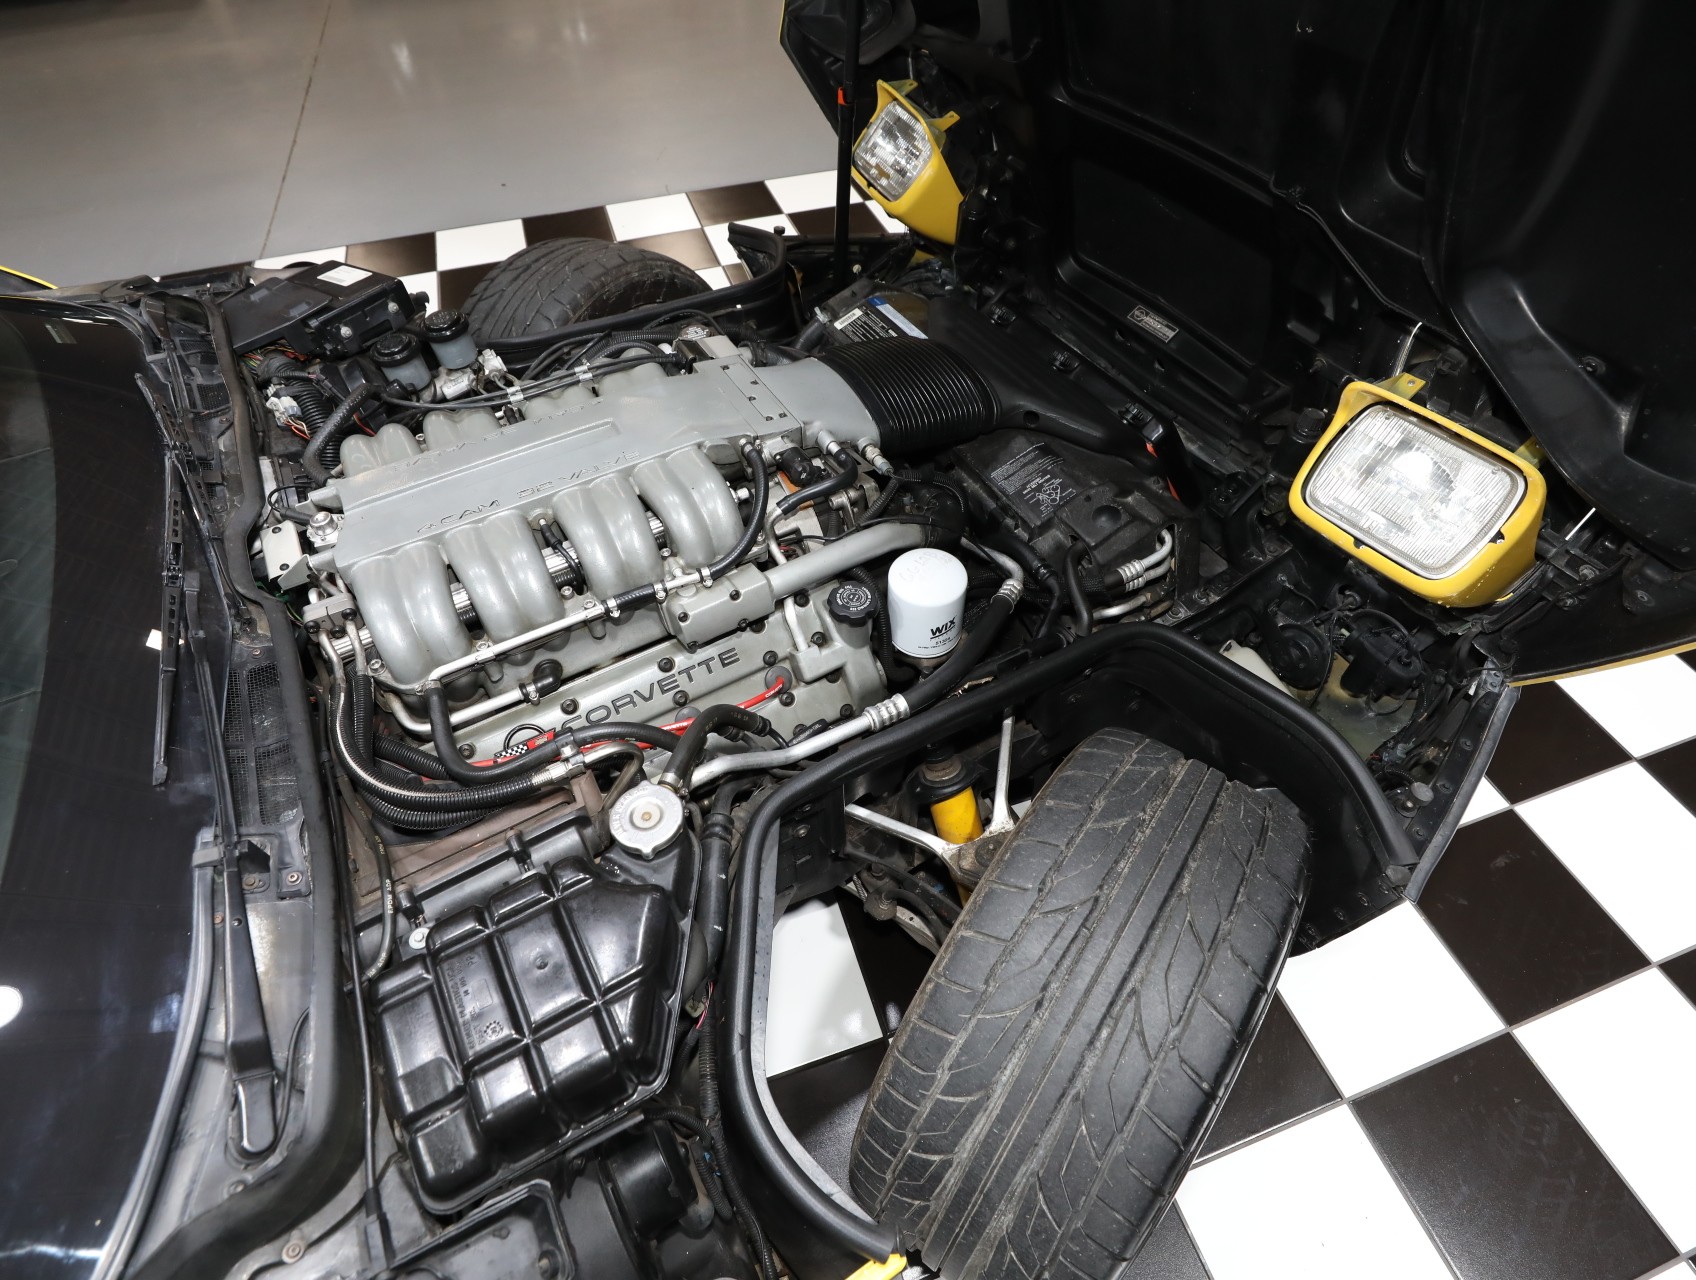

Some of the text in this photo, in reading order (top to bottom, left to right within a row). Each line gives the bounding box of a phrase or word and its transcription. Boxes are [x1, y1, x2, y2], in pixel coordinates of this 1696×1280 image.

[441, 499, 500, 525] CAM
[558, 451, 641, 481] VALVE
[930, 615, 957, 637] WIX
[561, 647, 741, 729] CORVETTE
[386, 894, 394, 914] EPDM
